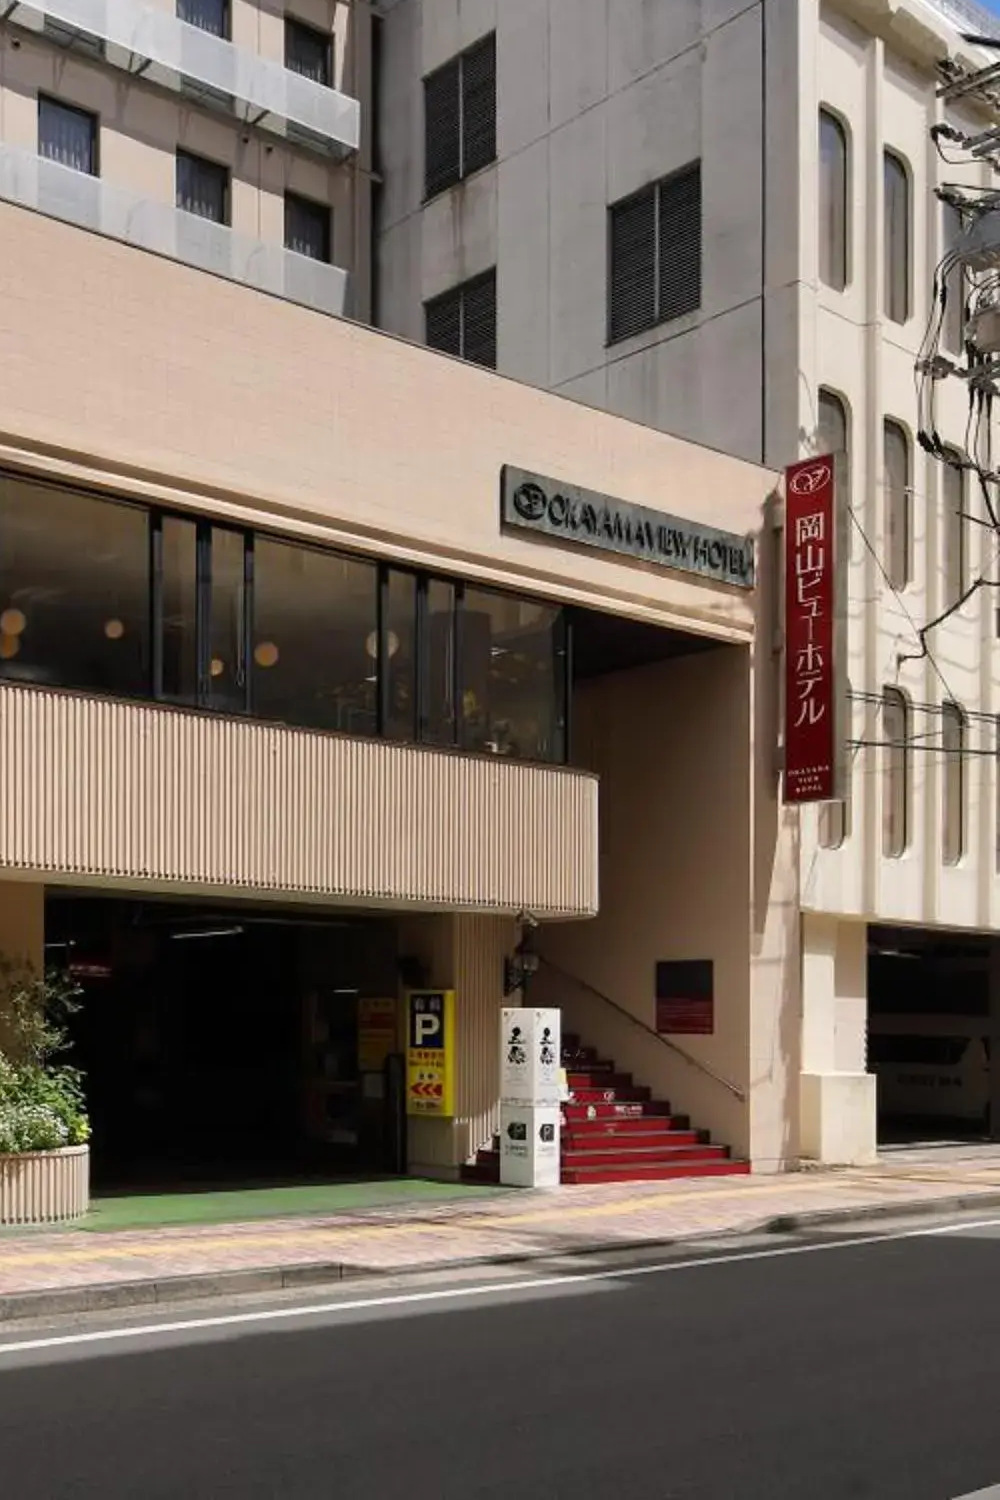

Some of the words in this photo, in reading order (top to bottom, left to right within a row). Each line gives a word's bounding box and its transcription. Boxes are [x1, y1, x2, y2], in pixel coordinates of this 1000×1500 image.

[548, 493, 645, 549] OKAYAMA
[692, 534, 749, 577] HOTEL
[794, 512, 825, 727] 岡山ビューホテル
[415, 1012, 440, 1045] P
